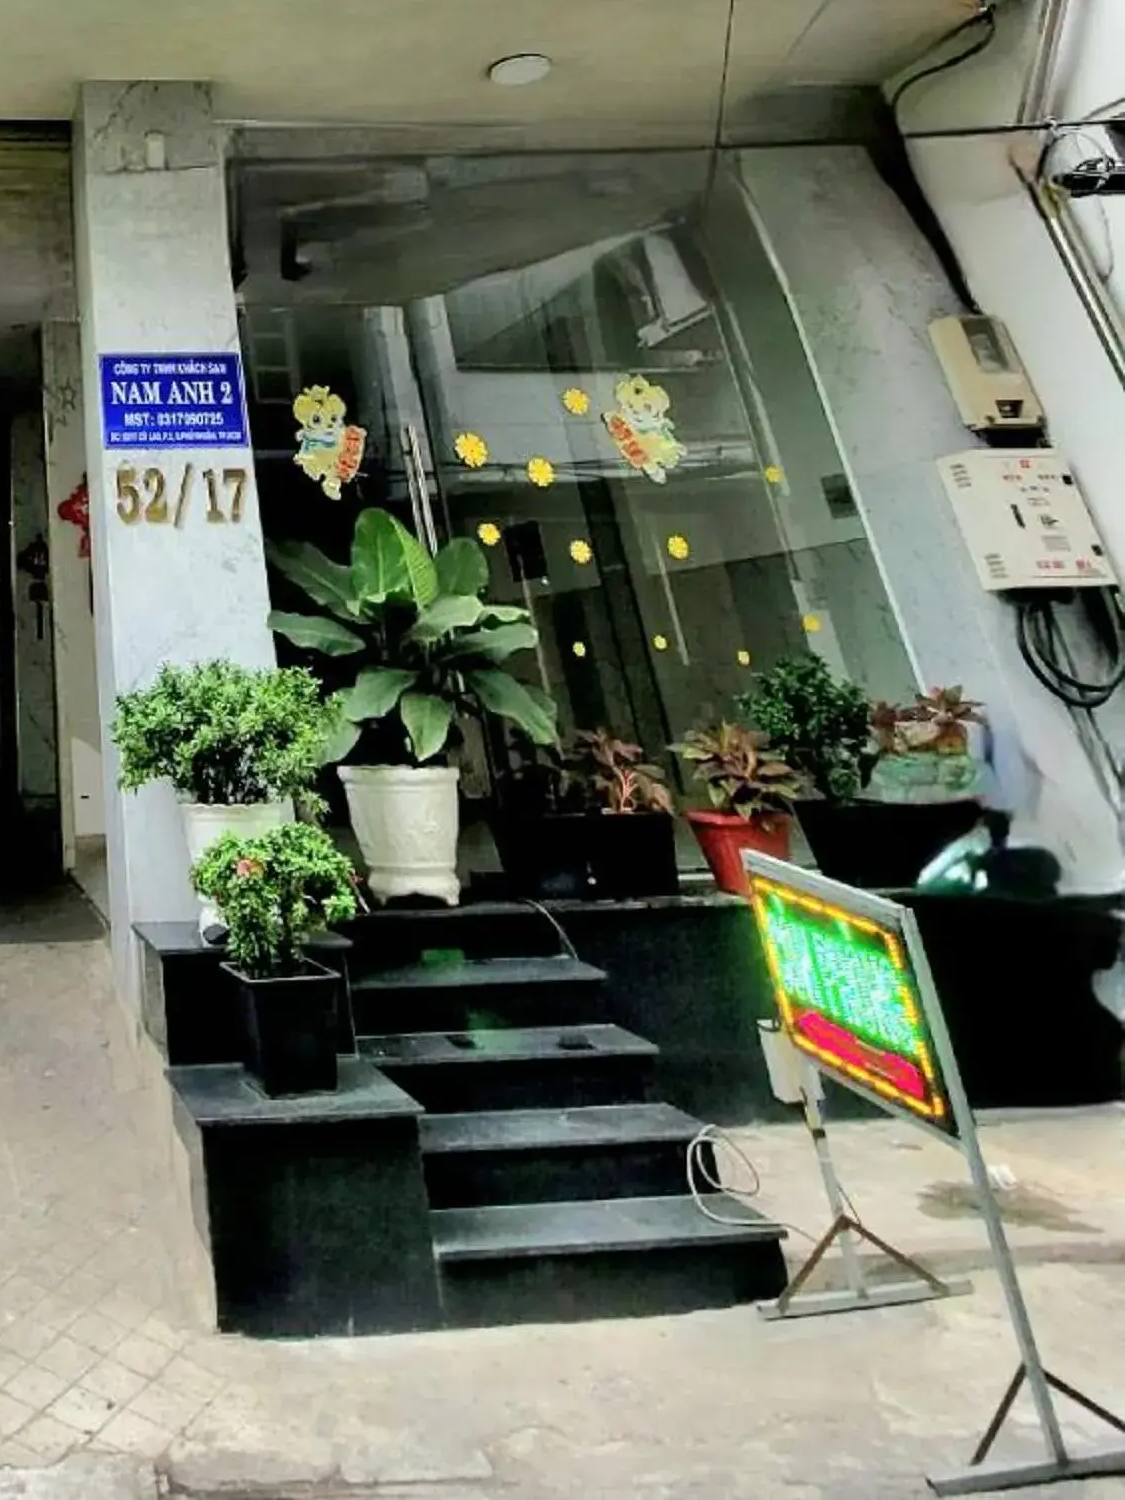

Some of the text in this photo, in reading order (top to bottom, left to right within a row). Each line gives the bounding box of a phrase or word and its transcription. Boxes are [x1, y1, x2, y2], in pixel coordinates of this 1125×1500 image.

[111, 381, 234, 405] NAM ANH 2
[116, 462, 248, 529] 52/17
